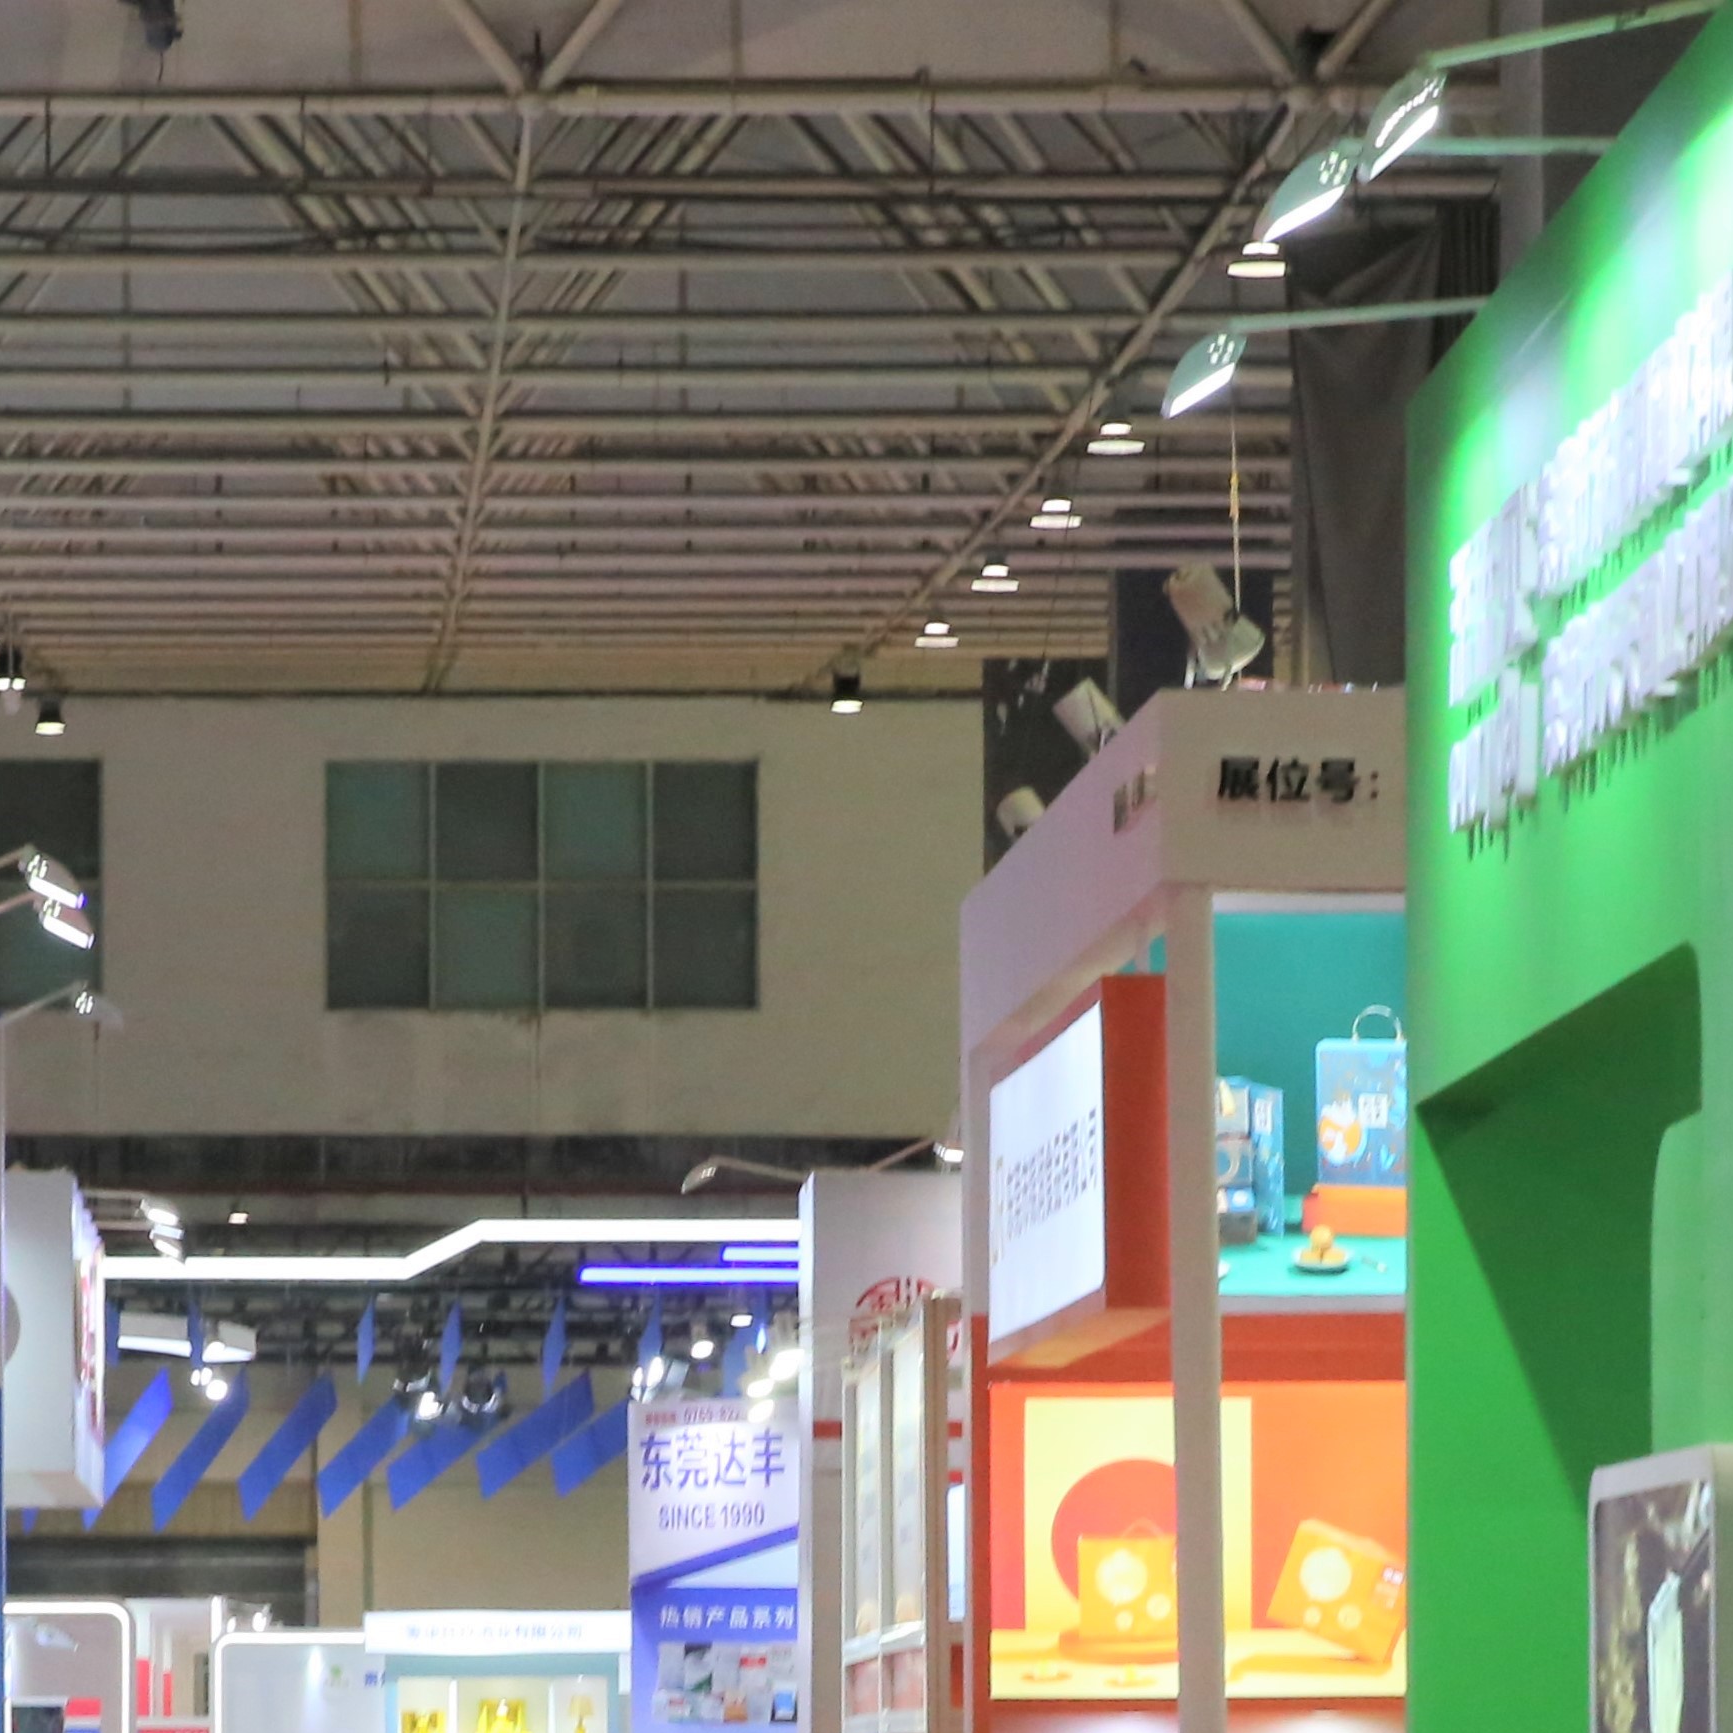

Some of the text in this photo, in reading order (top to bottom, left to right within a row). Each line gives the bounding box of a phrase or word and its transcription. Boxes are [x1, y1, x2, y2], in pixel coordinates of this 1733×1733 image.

[639, 1427, 786, 1491] 东莞达丰
[658, 1500, 766, 1531] SINCE 1990
[659, 1604, 796, 1630] 热销产品系列
